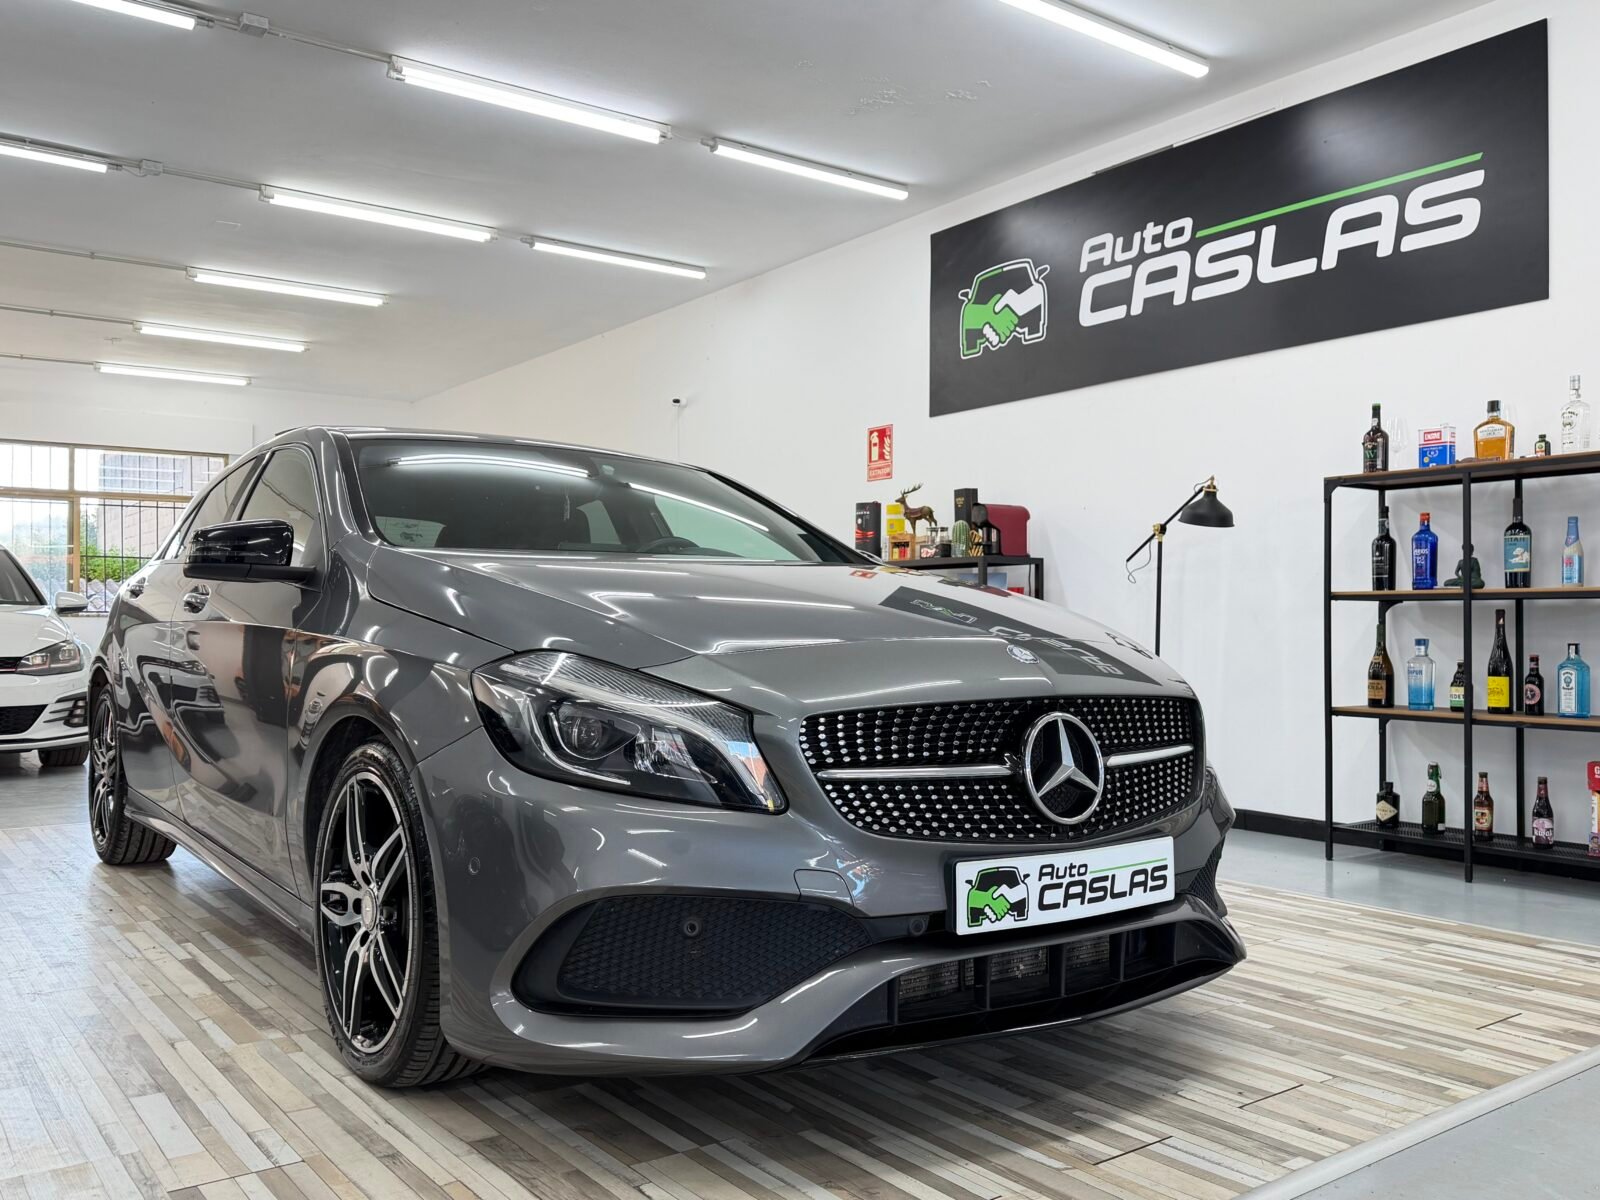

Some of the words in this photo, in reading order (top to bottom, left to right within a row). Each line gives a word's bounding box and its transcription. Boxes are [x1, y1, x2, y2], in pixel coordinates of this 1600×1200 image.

[1079, 216, 1194, 273] Auto
[1079, 169, 1485, 328] CASLAS
[1038, 863, 1088, 883] Auto
[1038, 864, 1168, 912] CASLAS
